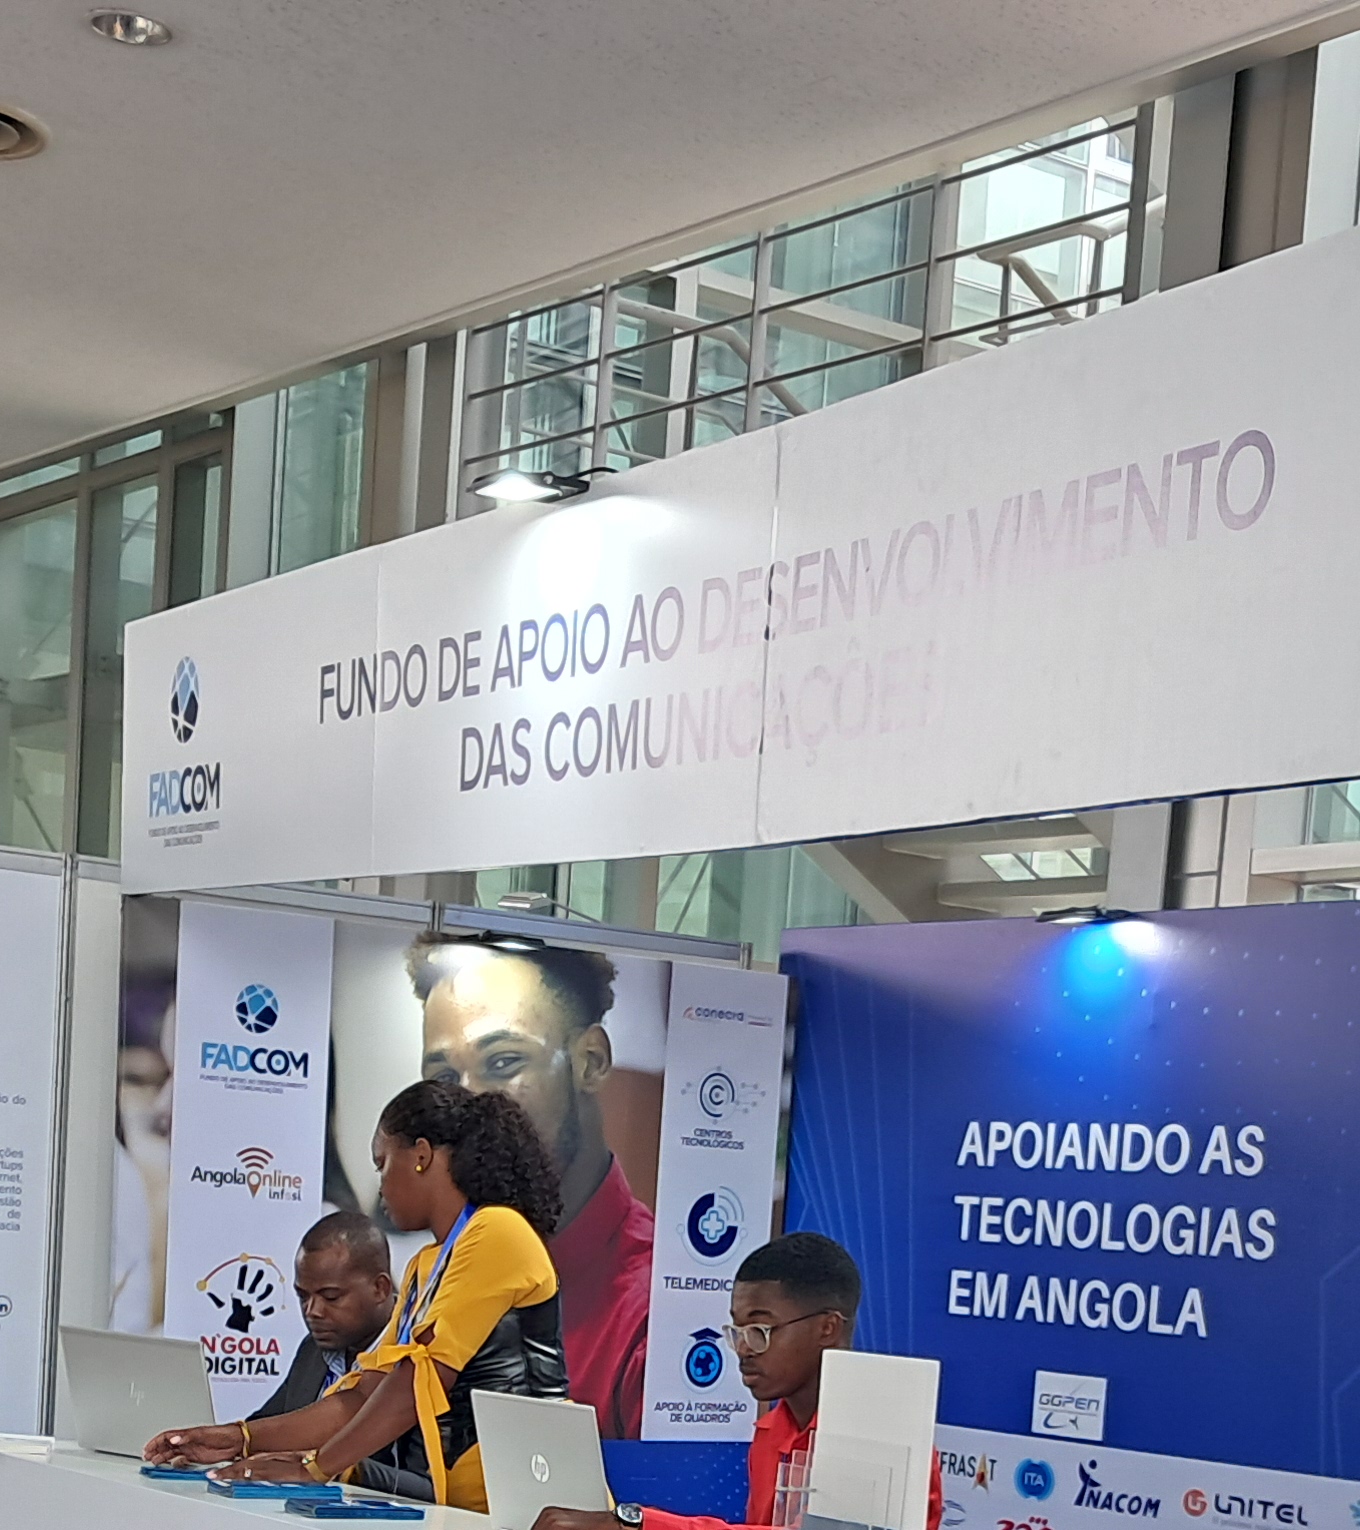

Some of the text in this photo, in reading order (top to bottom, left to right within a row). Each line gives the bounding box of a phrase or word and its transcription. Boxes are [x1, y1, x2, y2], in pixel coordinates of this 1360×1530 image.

[319, 429, 1276, 725] FUNDO DE APOIO AO DESENVOLVIMENTO
[459, 718, 531, 792] DAS
[149, 762, 220, 818] FADCOM
[201, 1042, 309, 1078] FADCOM
[693, 1127, 733, 1140] CENTROS
[957, 1121, 1265, 1177] APOIANDO AS
[954, 1195, 1276, 1260] TECNOLOGIAS
[948, 1269, 1207, 1338] EM ANGOLA
[654, 1400, 747, 1415] APOIO À FORMAÇÃO
[670, 1413, 731, 1424] DE QUADROS
[1039, 1393, 1100, 1412] GGPEN
[1024, 1472, 1045, 1487] ITA
[1214, 1493, 1308, 1526] UNITEL
